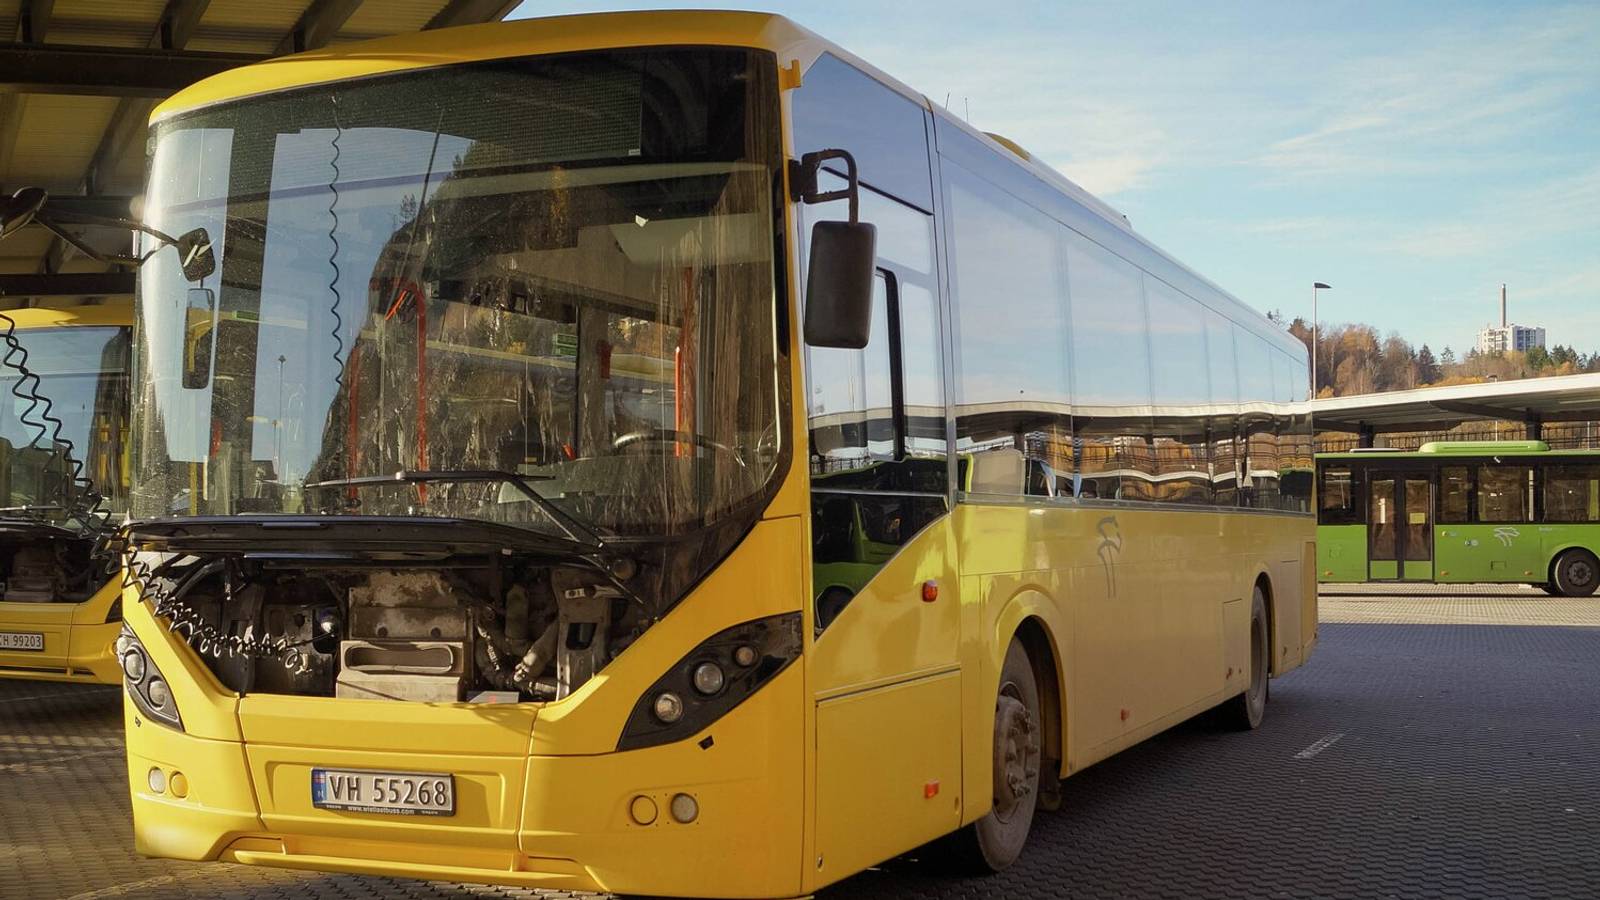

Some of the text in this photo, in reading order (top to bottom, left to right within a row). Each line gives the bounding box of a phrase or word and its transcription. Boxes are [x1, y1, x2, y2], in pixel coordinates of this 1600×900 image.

[0, 635, 41, 648] H 99203
[329, 775, 446, 806] VH 55268
